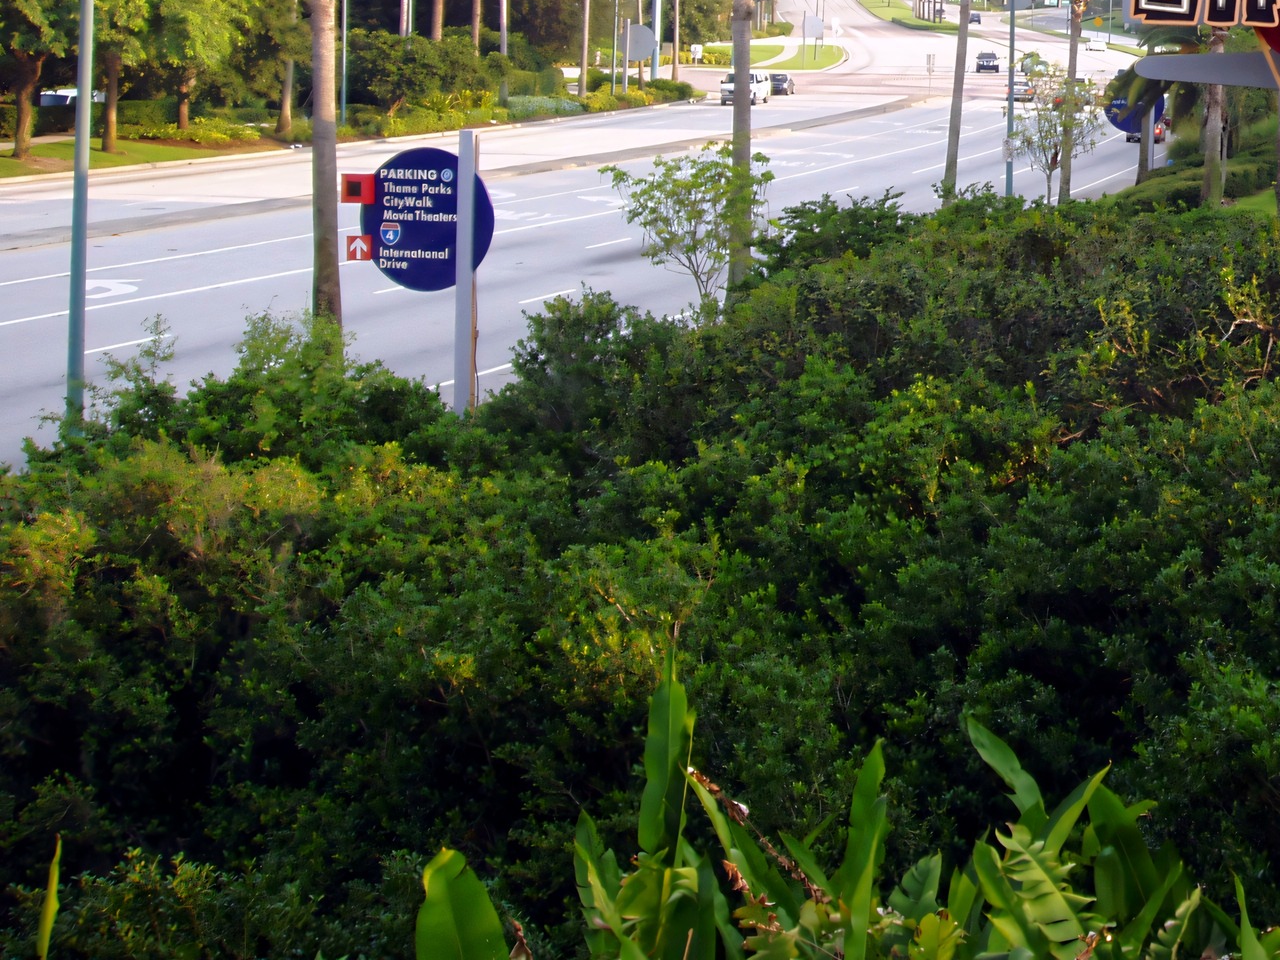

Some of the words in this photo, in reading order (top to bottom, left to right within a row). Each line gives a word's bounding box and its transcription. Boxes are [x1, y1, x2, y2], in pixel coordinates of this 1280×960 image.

[380, 168, 437, 180] PARKING
[383, 182, 418, 194] Theme
[421, 183, 452, 195] Parks
[383, 196, 433, 209] CityWalk
[383, 210, 413, 221] Movie
[415, 210, 458, 222] Theaters
[386, 230, 394, 241] 4
[380, 247, 449, 260] International
[380, 258, 408, 270] Drive
